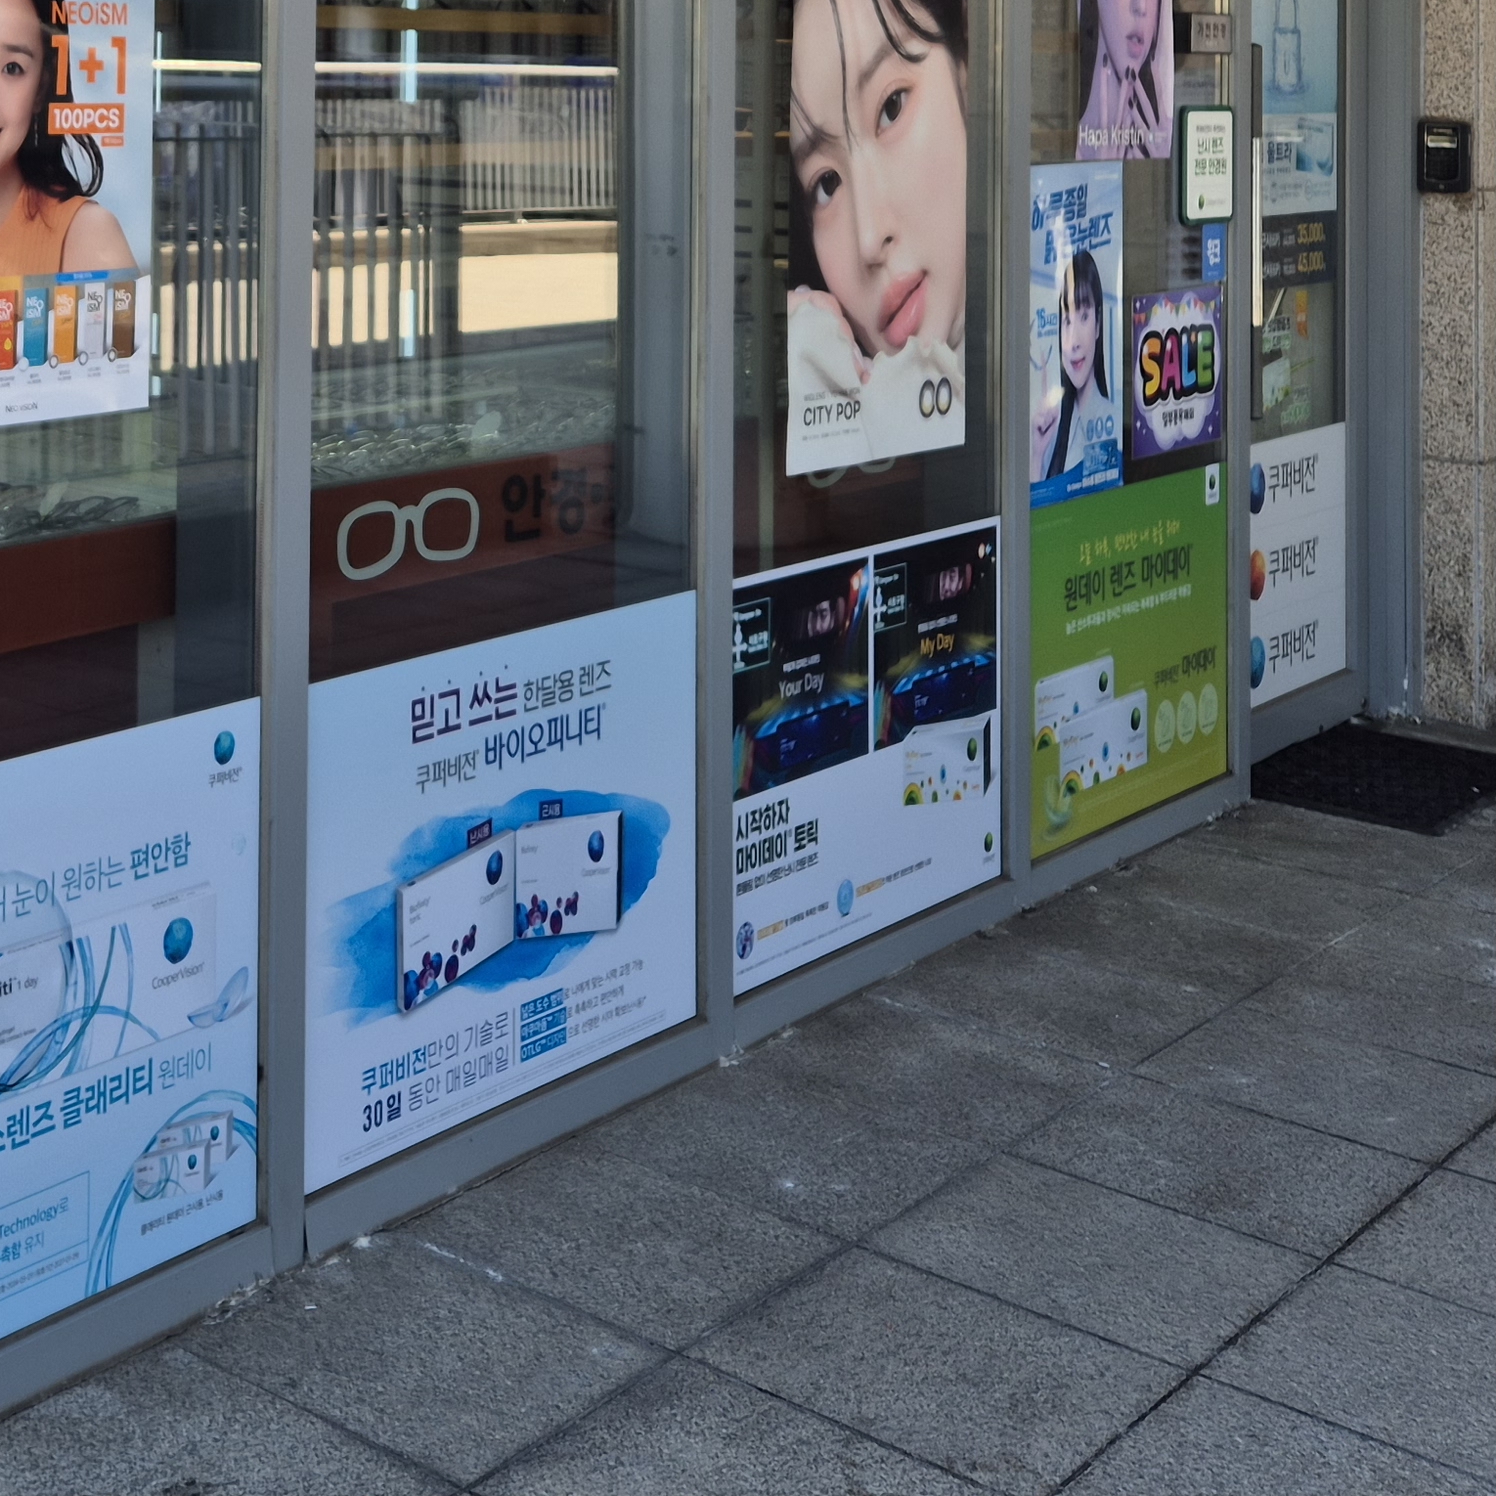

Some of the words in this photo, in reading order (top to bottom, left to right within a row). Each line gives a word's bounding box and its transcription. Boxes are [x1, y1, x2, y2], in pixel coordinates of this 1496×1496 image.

[51, 34, 127, 96] 1+1
[54, 108, 120, 129] 100PCS
[1078, 123, 1109, 149] Hapa
[1110, 123, 1145, 146] Kristin
[1297, 222, 1324, 245] 35,000
[1297, 251, 1324, 274] 45,000
[26, 296, 44, 309] NEO
[87, 291, 103, 302] NEO
[115, 289, 131, 301] NEO
[1141, 324, 1215, 408] SALE
[804, 404, 832, 426] CITY
[837, 400, 861, 421] POP
[1268, 454, 1316, 503] 쿠퍼비전
[1064, 567, 1106, 612] 원데이
[1110, 560, 1136, 597] 렌즈
[1141, 544, 1190, 589] 마이데이
[1268, 536, 1316, 587] 쿠퍼비전
[920, 636, 935, 656] My
[936, 633, 955, 651] Day
[1268, 619, 1316, 674] 쿠퍼비전
[411, 687, 461, 744] 믿고
[468, 676, 518, 727] 쓰는
[523, 669, 575, 713] 한달용
[579, 659, 612, 697] 렌즈
[779, 677, 803, 699] Your
[804, 672, 825, 694] Day
[484, 703, 601, 771] 바이오피니티
[736, 798, 790, 842] 시작하자
[736, 830, 787, 876] 마이데이
[794, 818, 819, 852] 토릭
[11, 877, 58, 918] 눈이
[59, 854, 126, 901] 원하는
[128, 830, 191, 879] 편안함
[16, 980, 22, 991] 1
[24, 976, 39, 990] day
[152, 964, 203, 990] CooperVision
[360, 1030, 459, 1096] 쿠퍼비전만의
[464, 1011, 510, 1053] 기술로
[59, 1057, 156, 1131] 클래리티
[156, 1041, 213, 1090] 원데이
[362, 1091, 402, 1133] 30일
[408, 1076, 440, 1112] 동안
[445, 1044, 510, 1092] 매일매일
[24, 1230, 45, 1253] 유지
